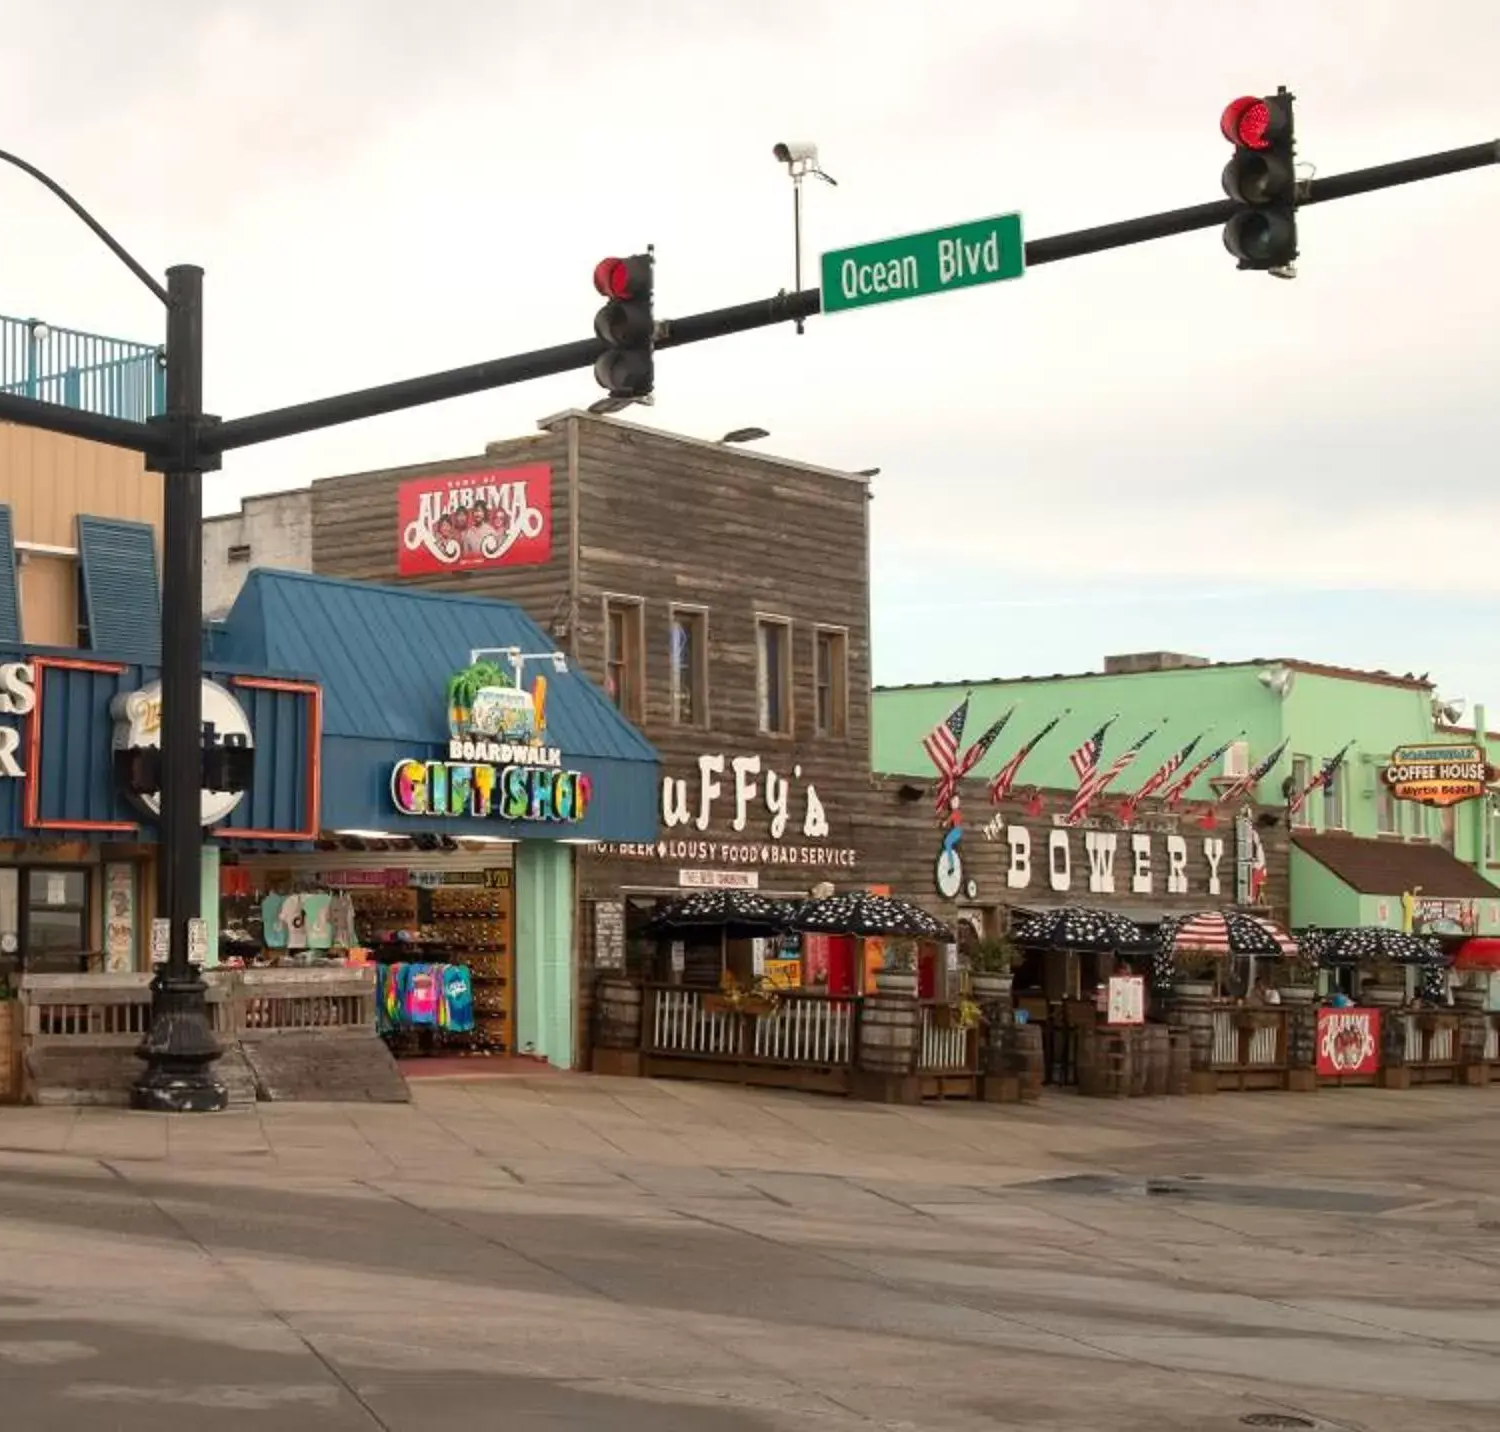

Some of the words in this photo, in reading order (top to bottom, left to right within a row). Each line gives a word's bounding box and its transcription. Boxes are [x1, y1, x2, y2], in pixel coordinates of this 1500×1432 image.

[841, 255, 919, 299] Ocean
[938, 230, 1000, 285] Blvd
[405, 481, 543, 550] ALABAMA
[450, 740, 561, 767] BOARDWALK
[1387, 765, 1436, 783] COFFEE
[1440, 763, 1485, 781] HOUSE
[391, 758, 496, 816] GIFT
[501, 765, 594, 822] SHOP
[662, 754, 829, 839] uFFy's
[1403, 785, 1438, 797] Myrtle
[1441, 784, 1475, 795] Beach
[620, 842, 655, 857] BEER
[670, 839, 717, 860] LOUSY
[722, 844, 758, 863] FOOD
[771, 845, 798, 864] BAD
[801, 847, 857, 866] SERVICE
[1007, 825, 1223, 895] BOWERY
